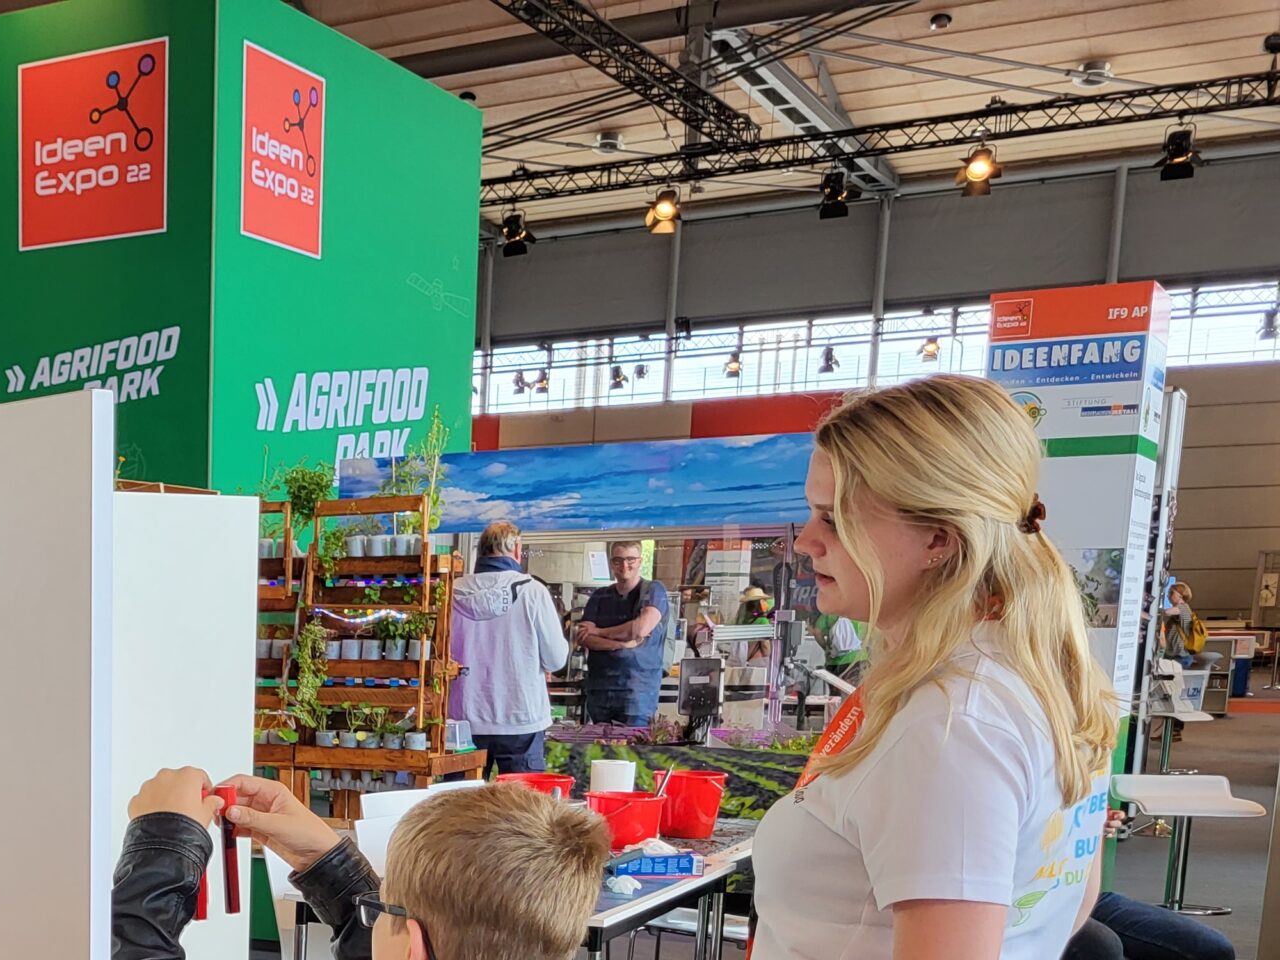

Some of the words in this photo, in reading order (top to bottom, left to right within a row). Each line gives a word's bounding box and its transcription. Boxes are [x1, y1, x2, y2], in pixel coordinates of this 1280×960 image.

[35, 131, 127, 166] Ideen
[252, 126, 303, 171] Ideen
[35, 164, 119, 196] Expo
[126, 163, 151, 183] 22
[251, 160, 299, 199] Expo
[301, 185, 314, 206] 22
[1107, 307, 1128, 320] IF9
[1131, 305, 1148, 318] AP
[29, 326, 181, 390] AGRIFOOD
[993, 339, 1141, 370] IDEENFANG
[1035, 375, 1080, 384] Entdecken
[1091, 371, 1138, 381] Entwickeln
[282, 367, 429, 432] AGRIFOOD
[820, 706, 861, 758] verändern
